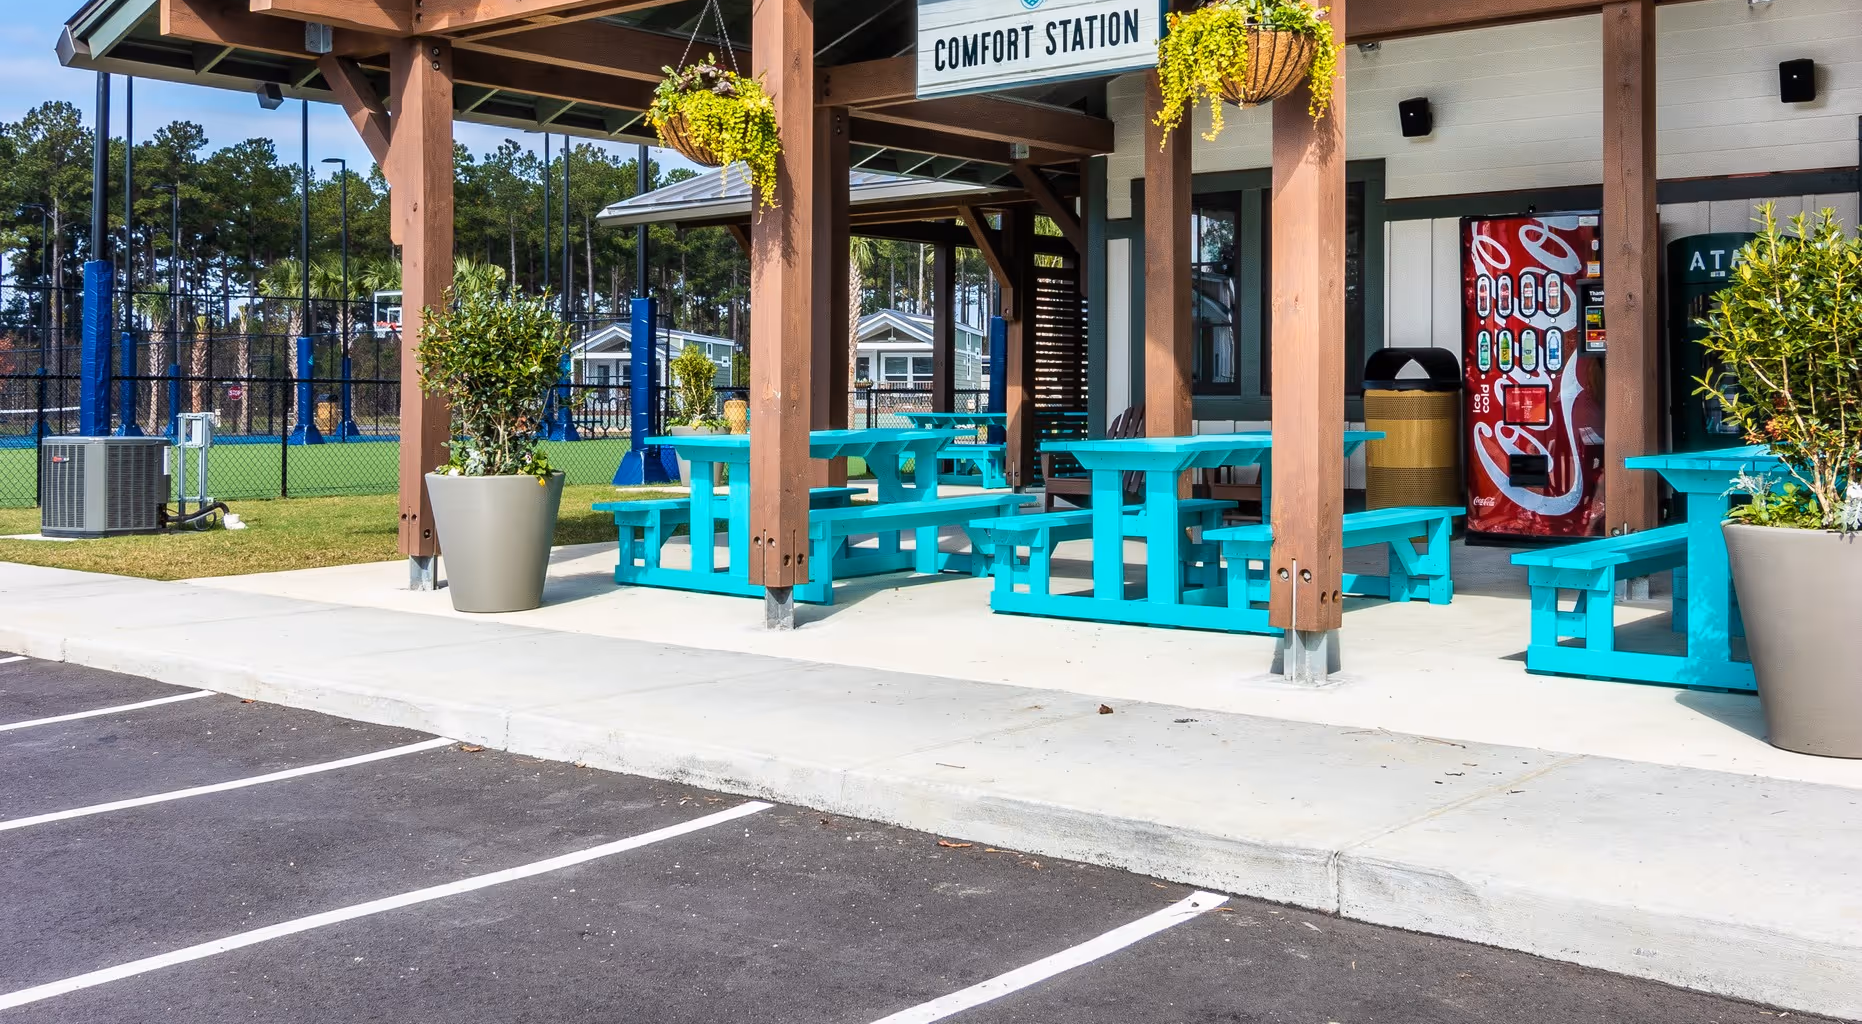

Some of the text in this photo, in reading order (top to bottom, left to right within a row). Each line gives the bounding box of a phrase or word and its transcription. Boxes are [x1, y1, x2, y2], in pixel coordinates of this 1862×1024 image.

[934, 8, 1139, 72] COMFORT STATION
[1472, 393, 1481, 413] Ice
[1480, 384, 1490, 414] cold
